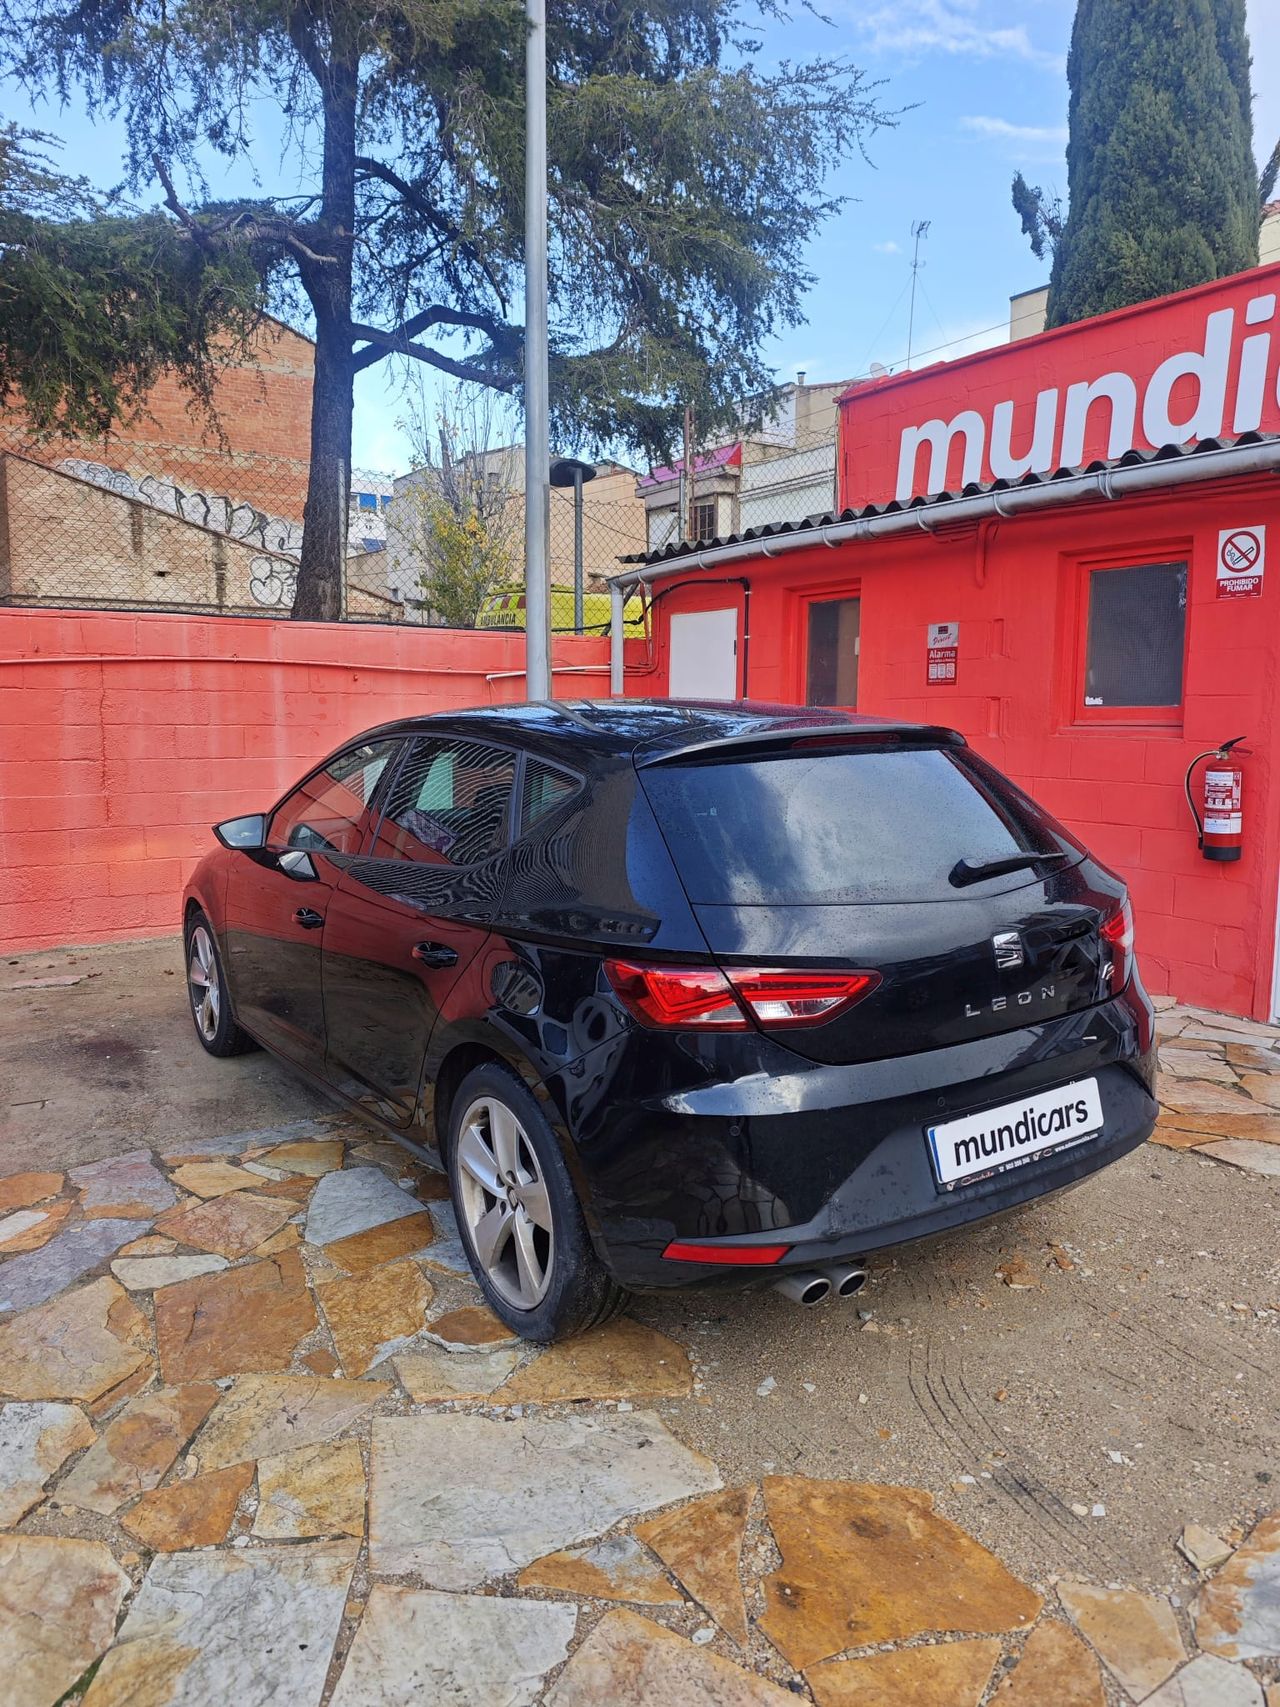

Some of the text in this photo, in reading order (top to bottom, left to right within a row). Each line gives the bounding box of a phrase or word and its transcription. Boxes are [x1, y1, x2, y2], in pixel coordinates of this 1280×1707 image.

[895, 293, 1280, 501] mundi
[1219, 577, 1259, 587] PROHIBIDO
[1226, 584, 1253, 592] FUMAR
[929, 649, 956, 661] Alarma
[964, 985, 1055, 1018] LEON
[954, 1099, 1088, 1167] mundicars
